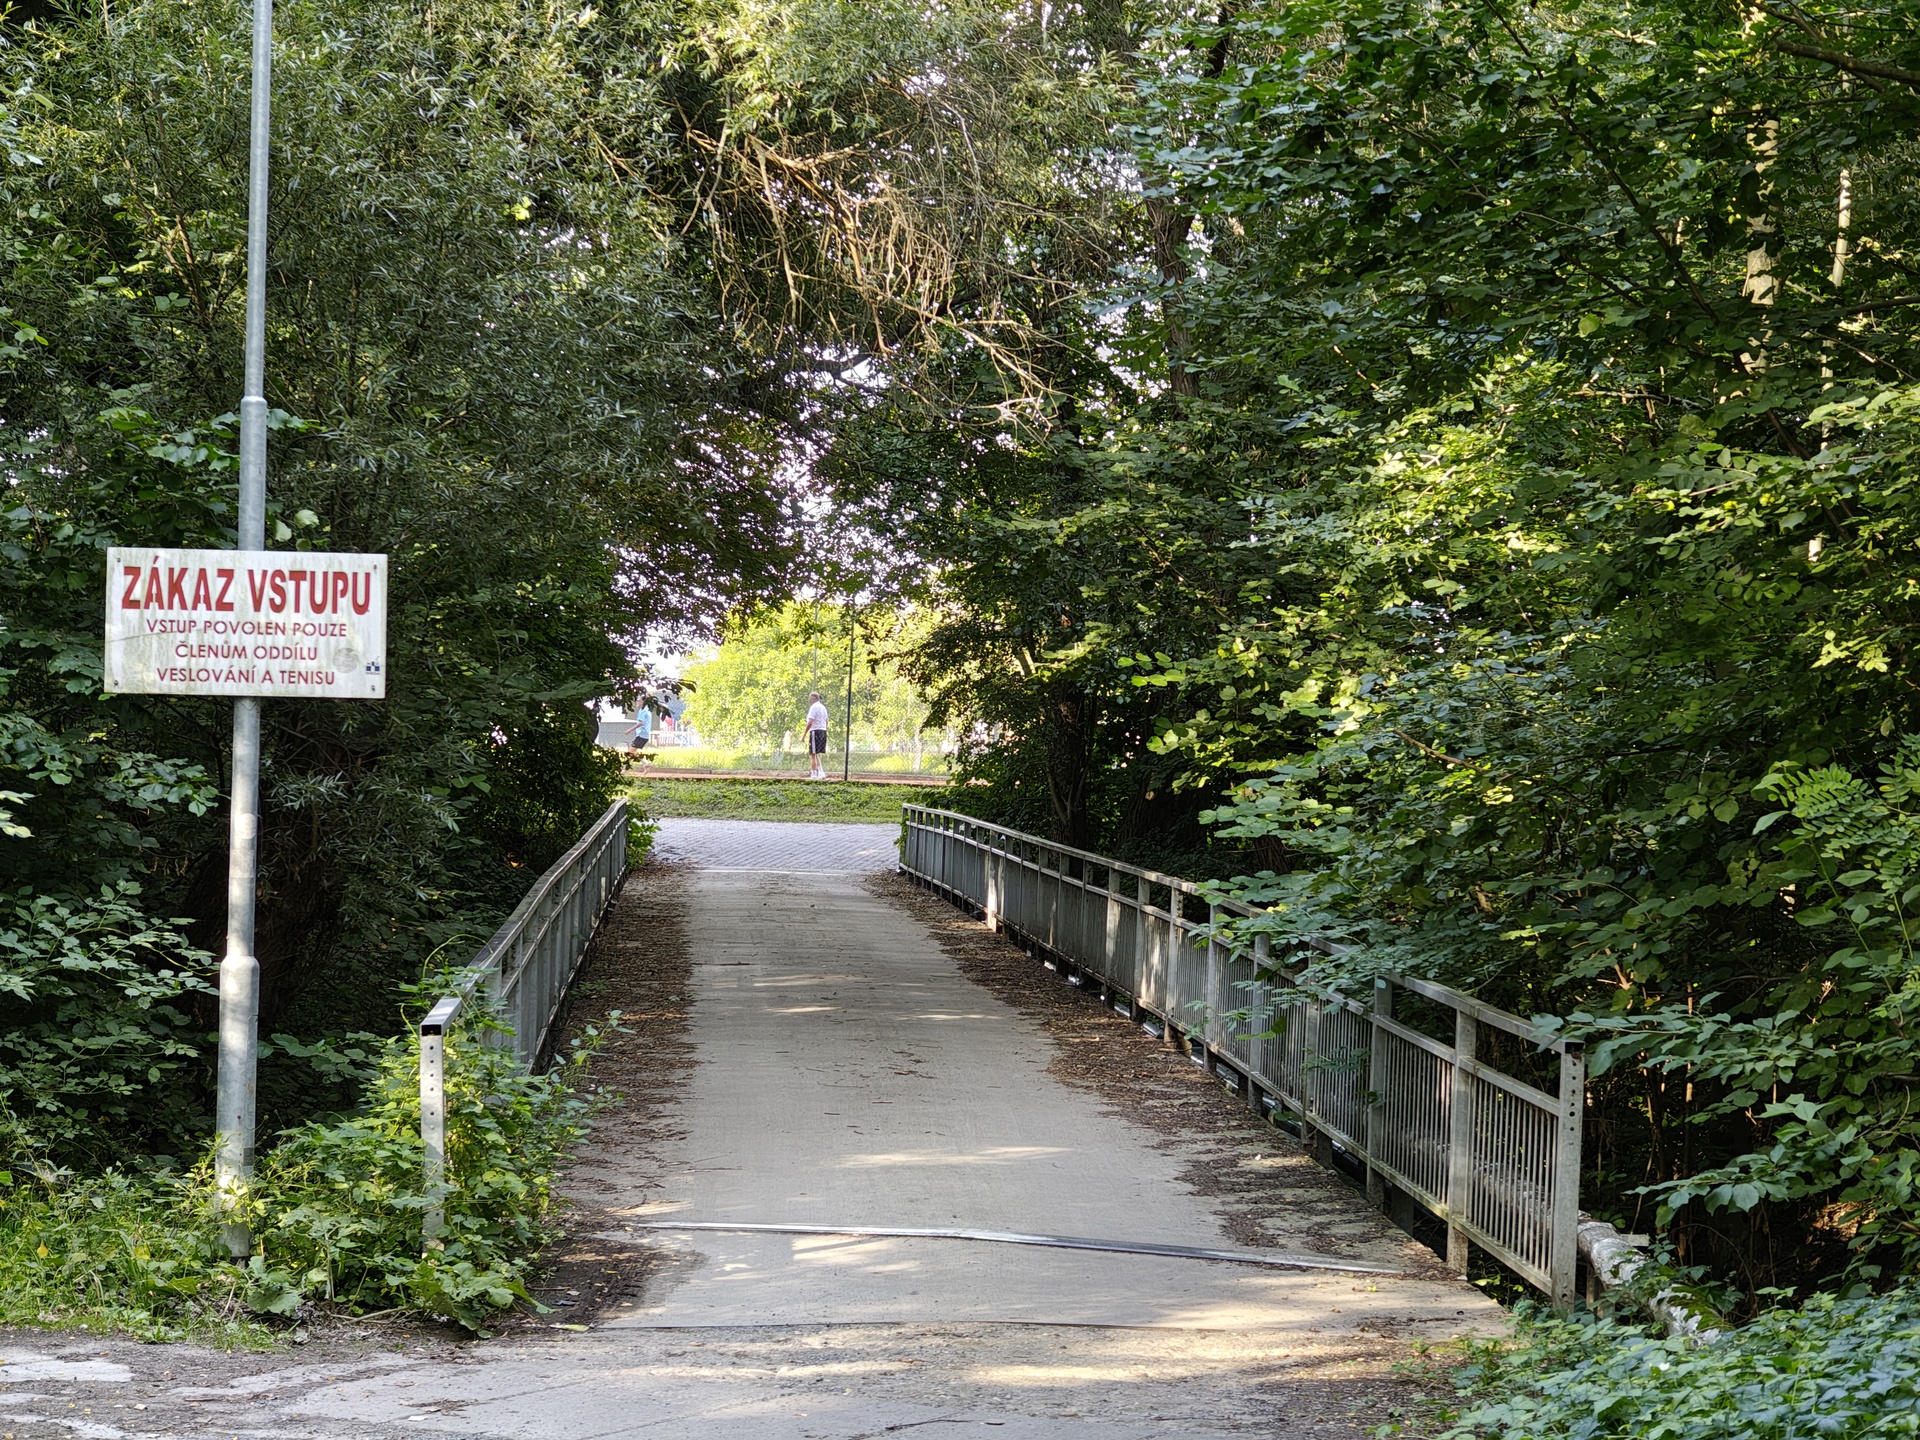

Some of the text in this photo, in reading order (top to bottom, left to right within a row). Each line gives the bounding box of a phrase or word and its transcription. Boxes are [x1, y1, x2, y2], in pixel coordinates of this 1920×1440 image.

[122, 556, 370, 615] ZÁKAZ VSTUPU
[146, 619, 346, 637] VSTUP POVOLEN POUZE
[175, 641, 317, 660] ČLENŮM ODDÍLU
[157, 666, 334, 684] VESLOVÁNÍ A TENISU
